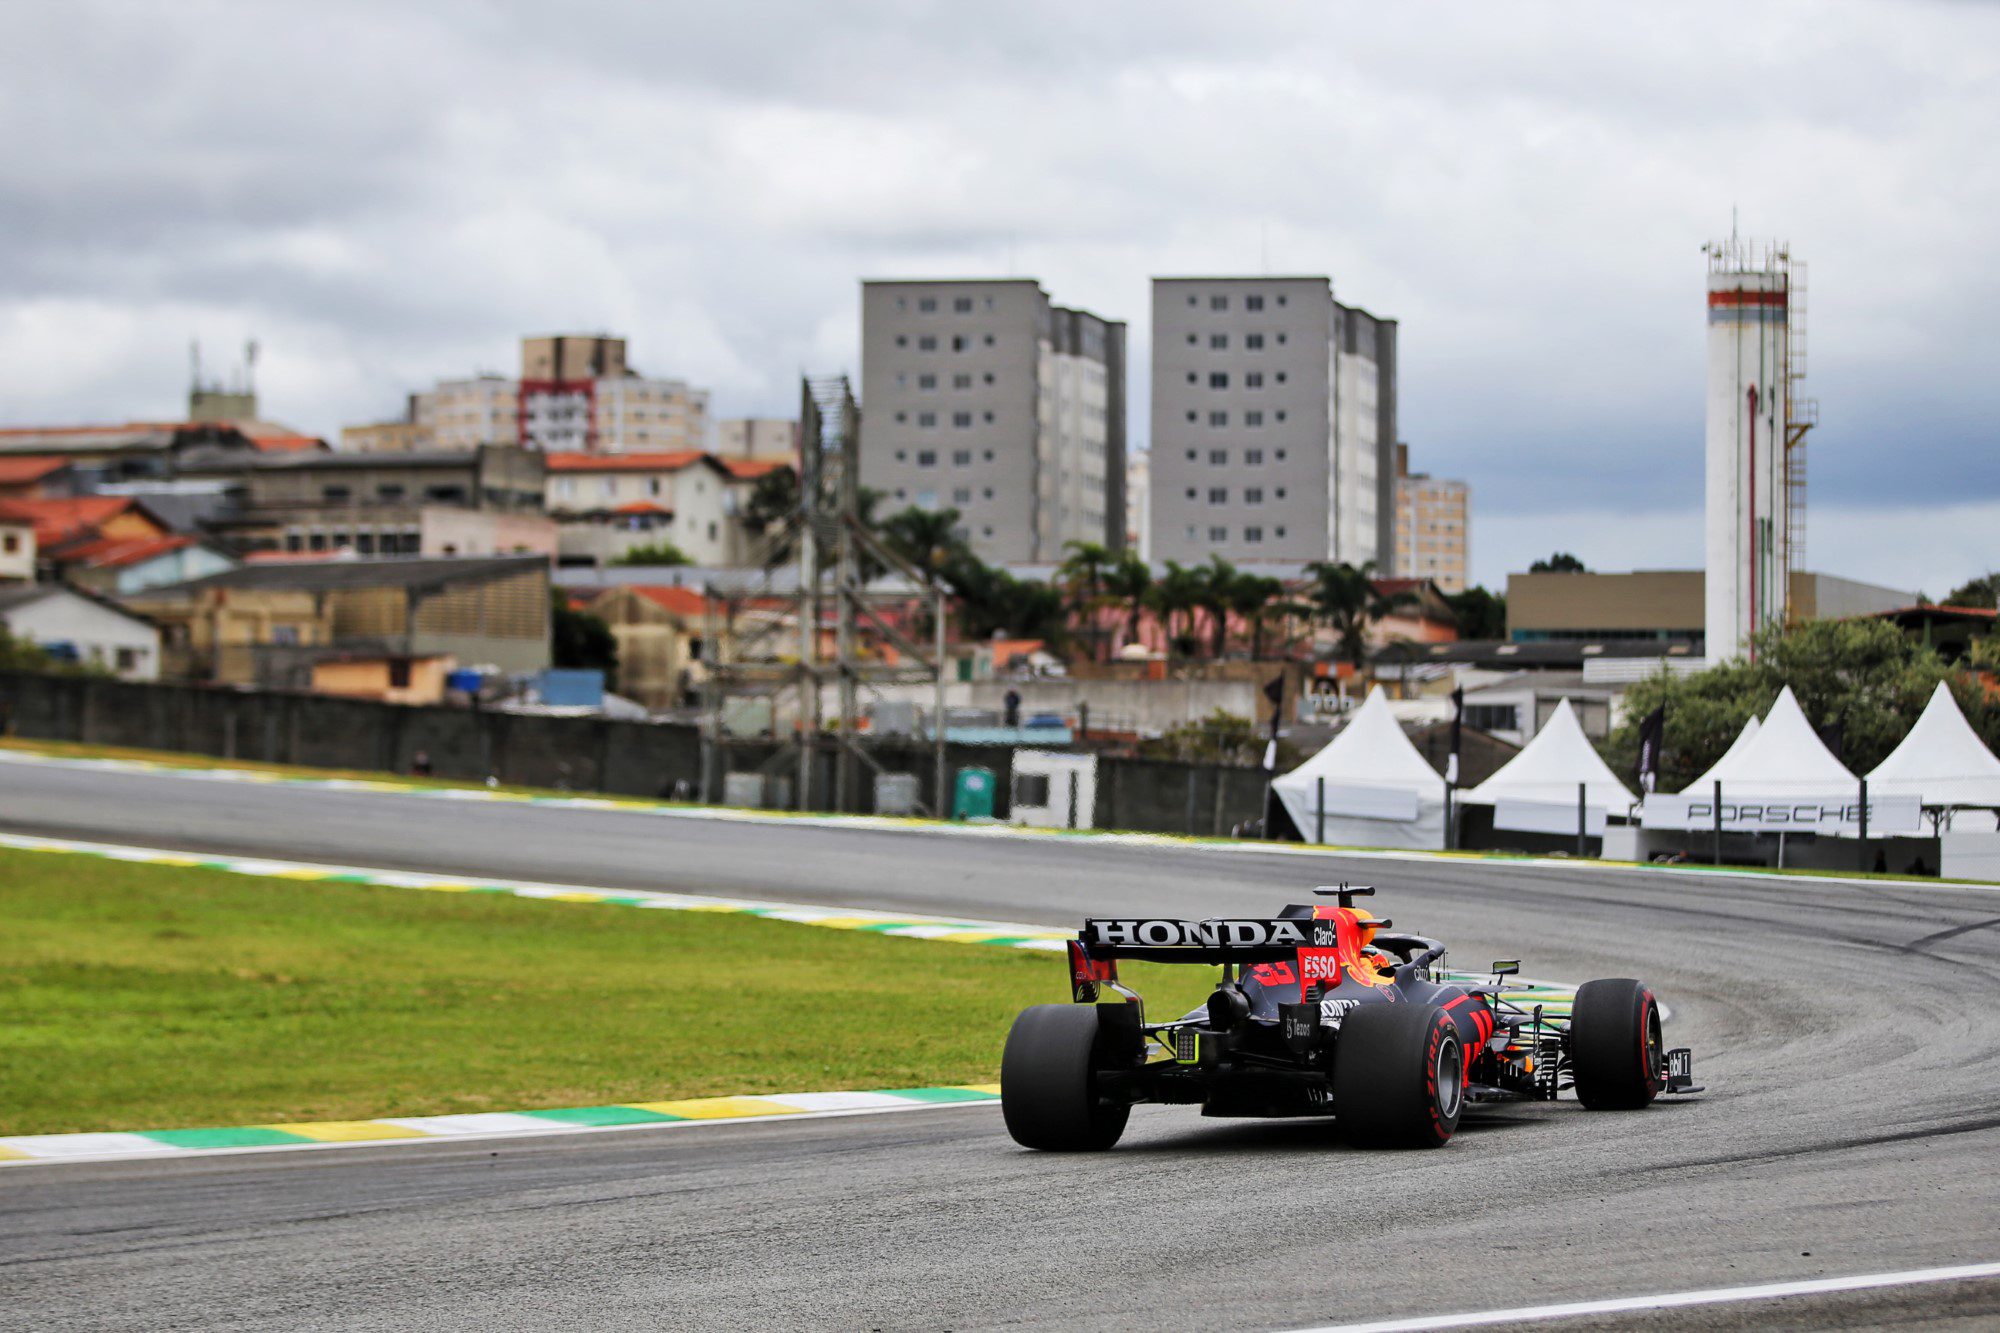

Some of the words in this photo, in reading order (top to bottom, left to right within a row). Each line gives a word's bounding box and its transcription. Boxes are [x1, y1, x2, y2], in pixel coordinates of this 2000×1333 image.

[1688, 803, 1872, 823] PORSCHE
[1091, 920, 1306, 946] HONDA
[1304, 955, 1336, 978] ESSO
[1293, 1018, 1310, 1037] Tezos
[1427, 1027, 1440, 1097] ZERO
